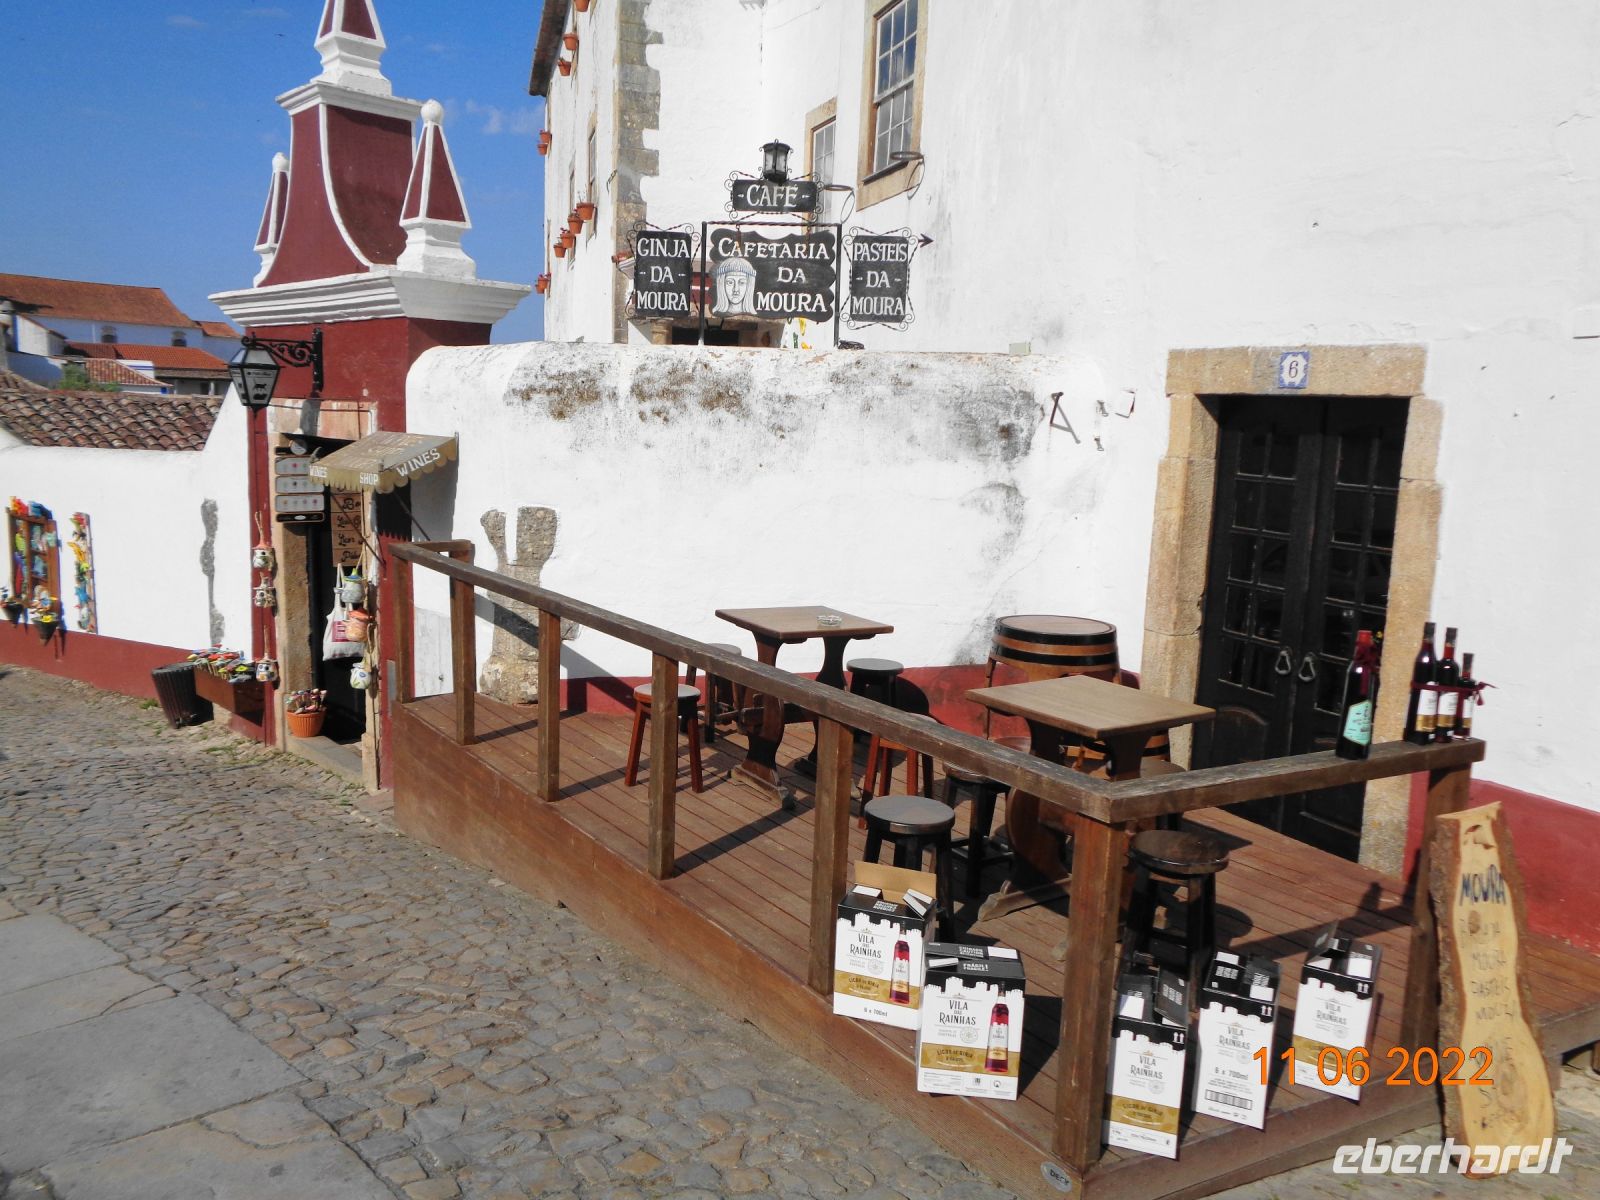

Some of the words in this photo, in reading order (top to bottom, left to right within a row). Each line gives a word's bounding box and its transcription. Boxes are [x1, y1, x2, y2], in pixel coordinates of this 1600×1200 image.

[746, 184, 798, 207] CAFÉ
[637, 237, 690, 258] GINJA
[718, 237, 830, 259] CAFETARIA
[853, 242, 908, 262] PASTEIS
[650, 266, 675, 283] DA
[777, 267, 807, 284] DA
[866, 271, 891, 288] DA
[636, 290, 689, 311] MOURA
[756, 291, 827, 313] MOURA
[852, 296, 905, 316] MOURA
[1289, 360, 1299, 379] 6
[396, 448, 440, 477] WINES
[309, 465, 328, 478] WINES
[360, 472, 379, 486] SHOP
[858, 933, 875, 945] VILA
[850, 943, 882, 959] RAINHAS
[949, 999, 968, 1011] VILA
[939, 1012, 976, 1026] RAINHAS
[1227, 1026, 1245, 1038] VILA
[1219, 1034, 1250, 1051] RAINHAS
[1139, 1055, 1157, 1067] VILA
[1130, 1064, 1164, 1080] RAINHAS
